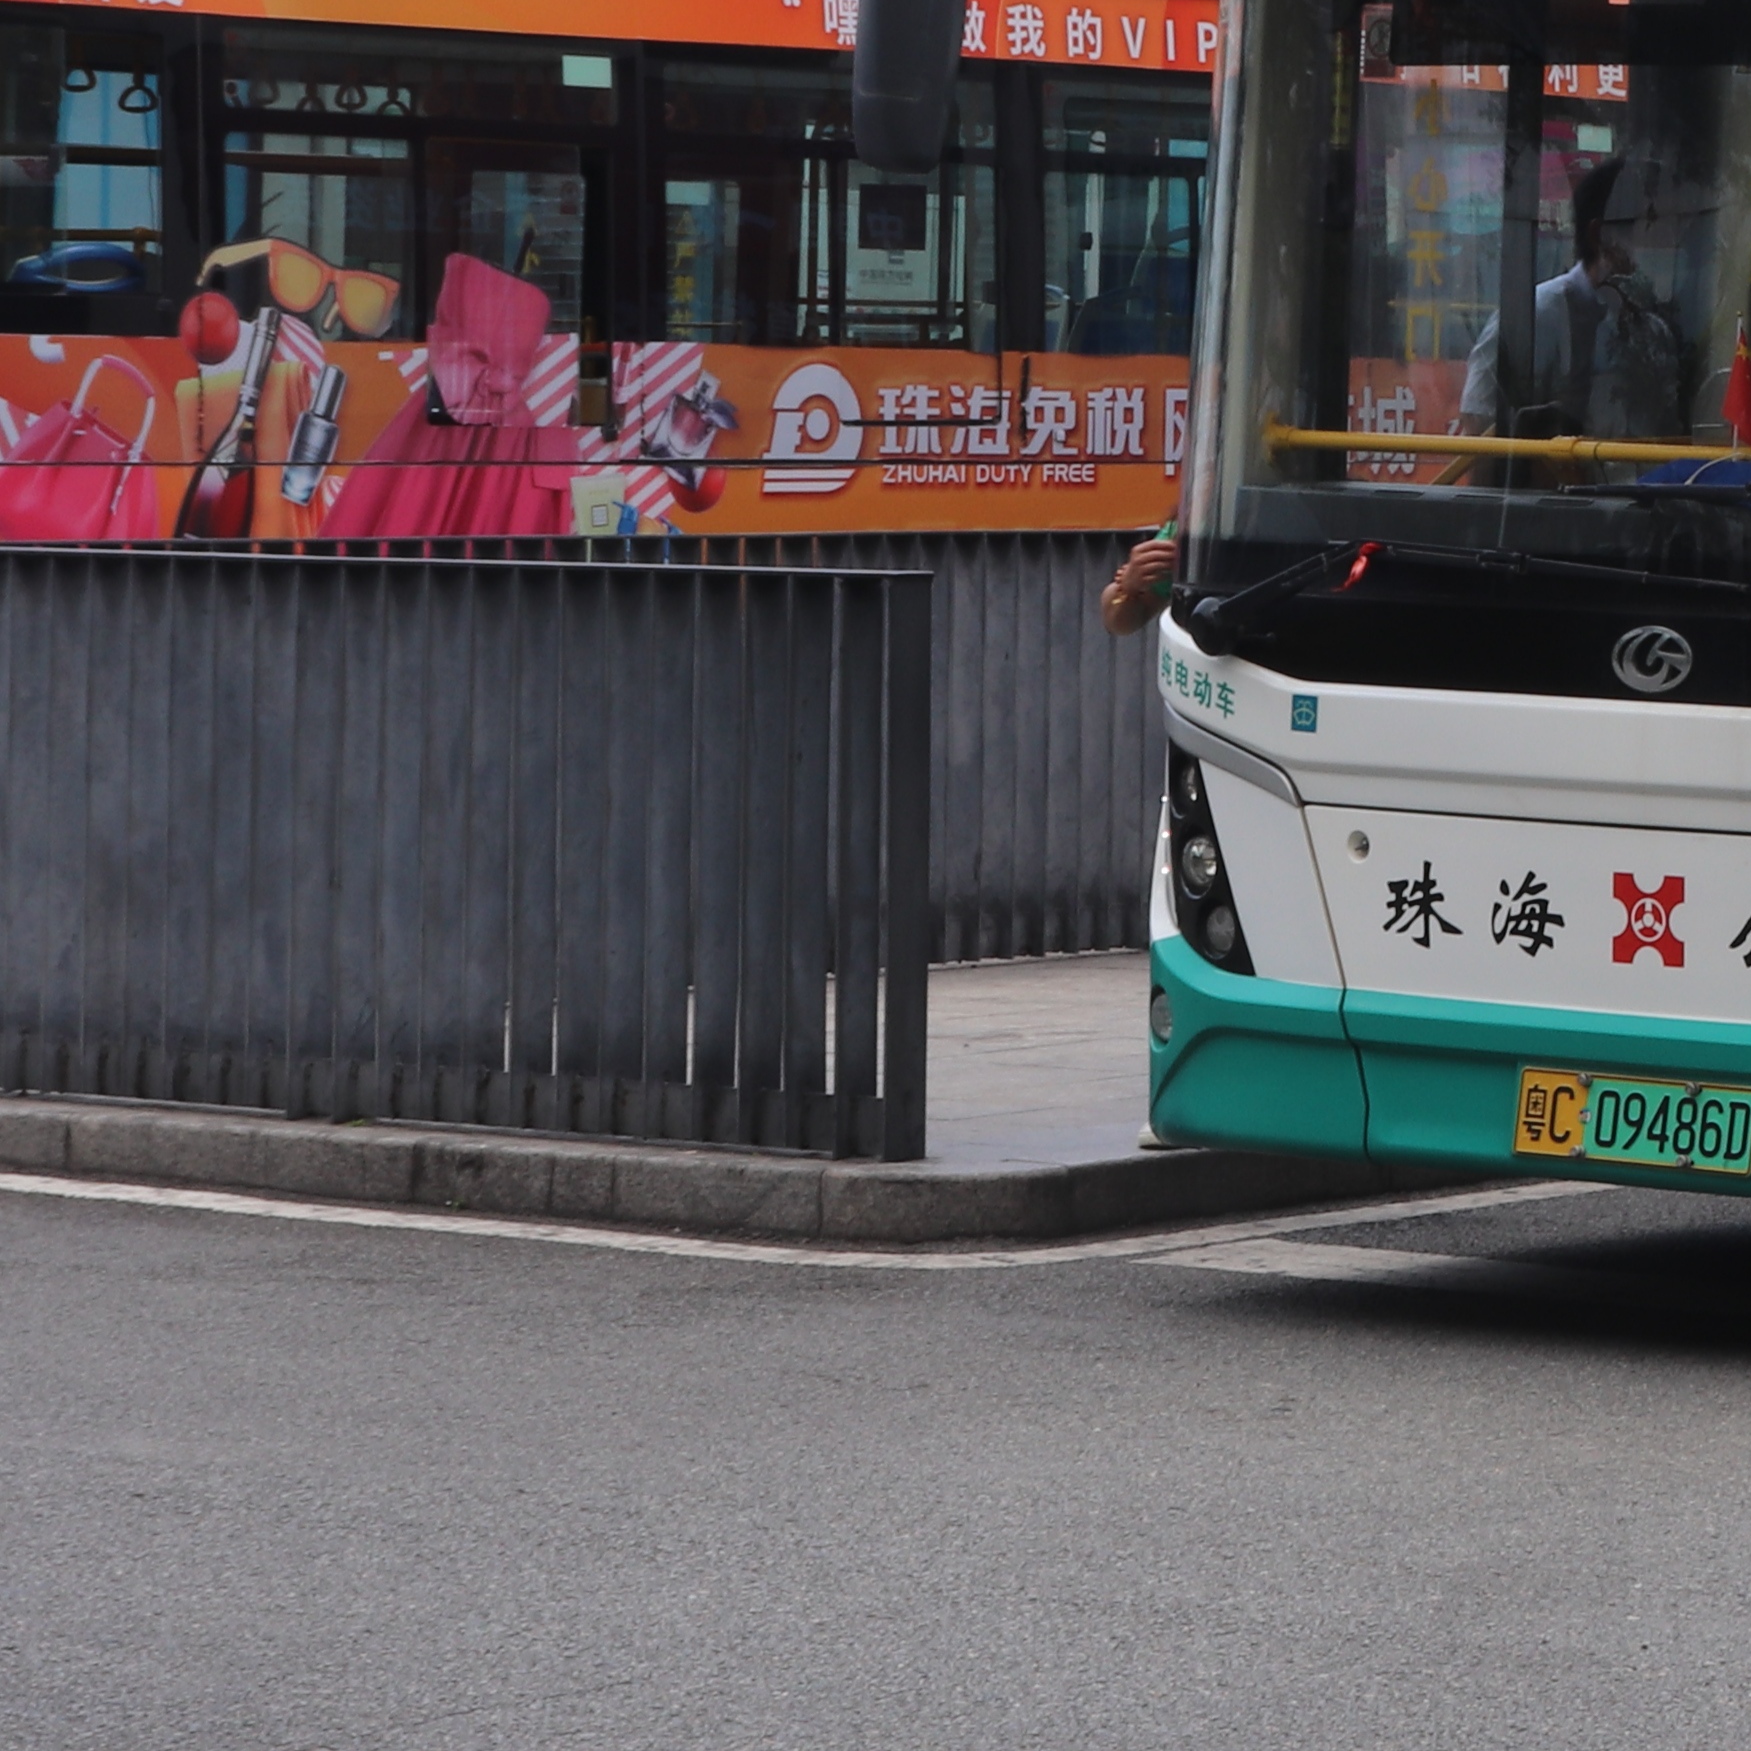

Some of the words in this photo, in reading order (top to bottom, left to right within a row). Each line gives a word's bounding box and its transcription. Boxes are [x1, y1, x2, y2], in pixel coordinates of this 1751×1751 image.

[882, 464, 965, 483] ZHUHAI
[975, 464, 1032, 483] DUTY
[1042, 464, 1095, 483] FREE
[1161, 651, 1236, 719] 纯电动车
[1383, 860, 1566, 957] 珠海
[1594, 1089, 1751, 1161] 09486D
